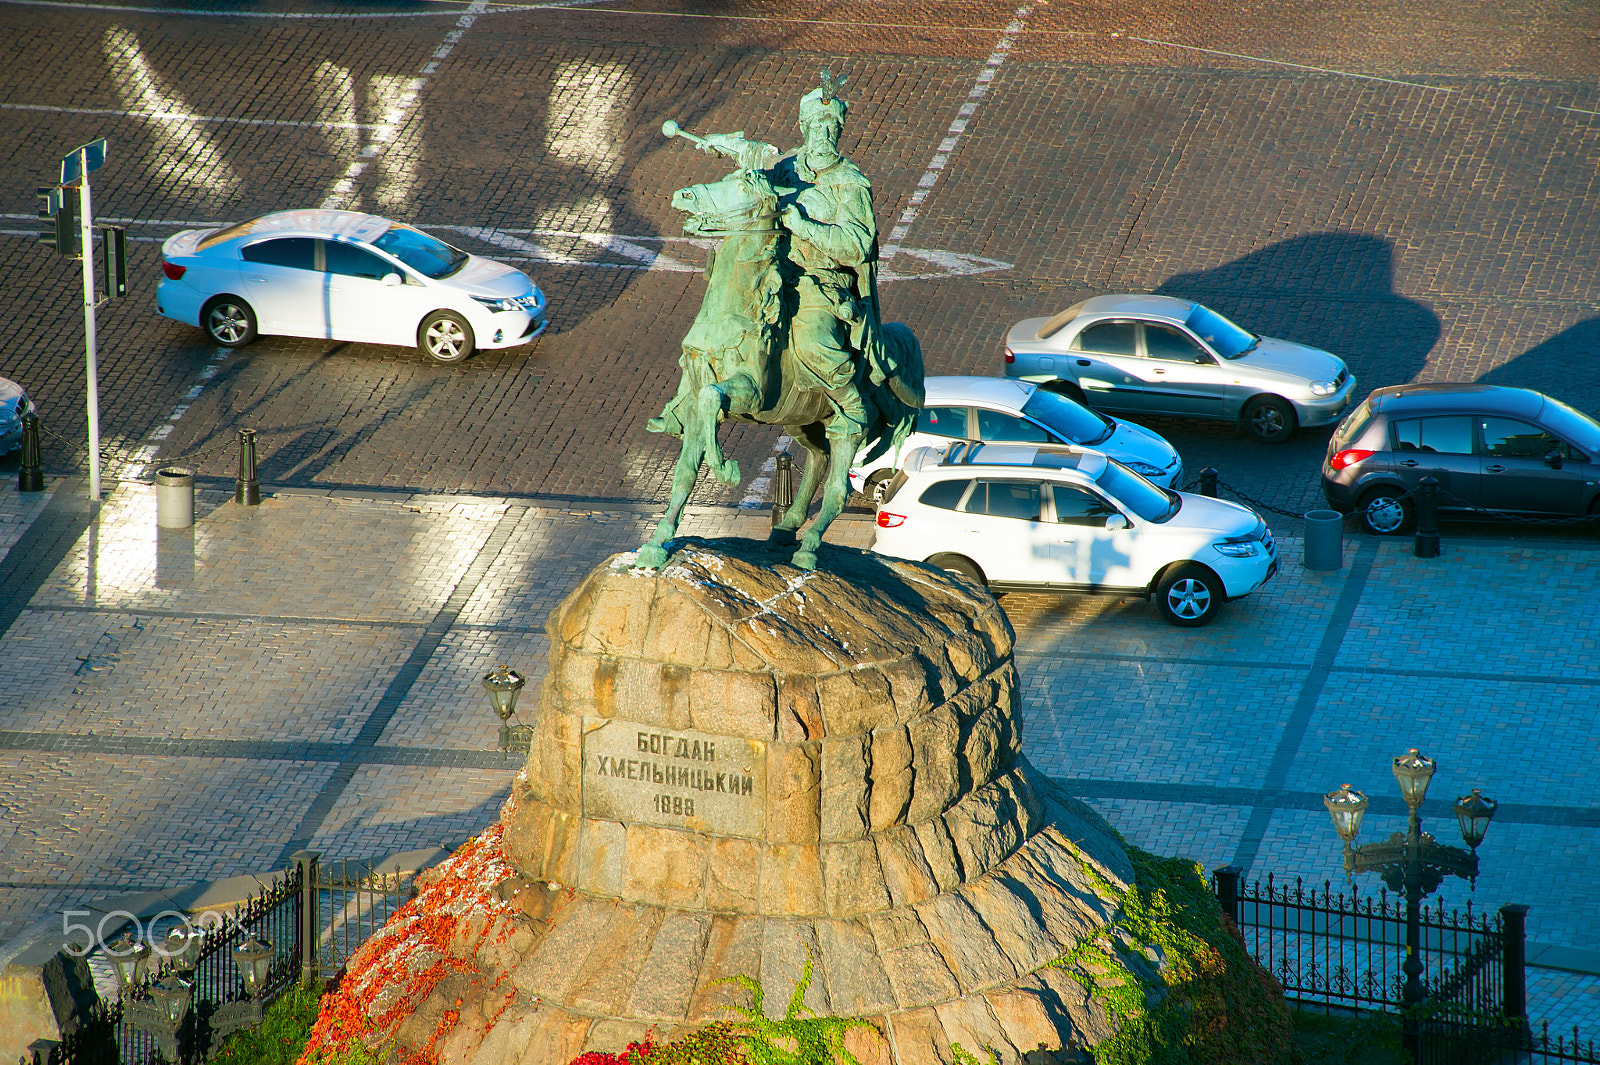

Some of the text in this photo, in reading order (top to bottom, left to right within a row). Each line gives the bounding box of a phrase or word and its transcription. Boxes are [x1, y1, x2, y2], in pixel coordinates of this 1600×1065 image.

[637, 732, 715, 761] БОГДАН
[597, 755, 753, 795] ХМЕЛЬНИЦЬКИЙ
[653, 793, 695, 816] 1888
